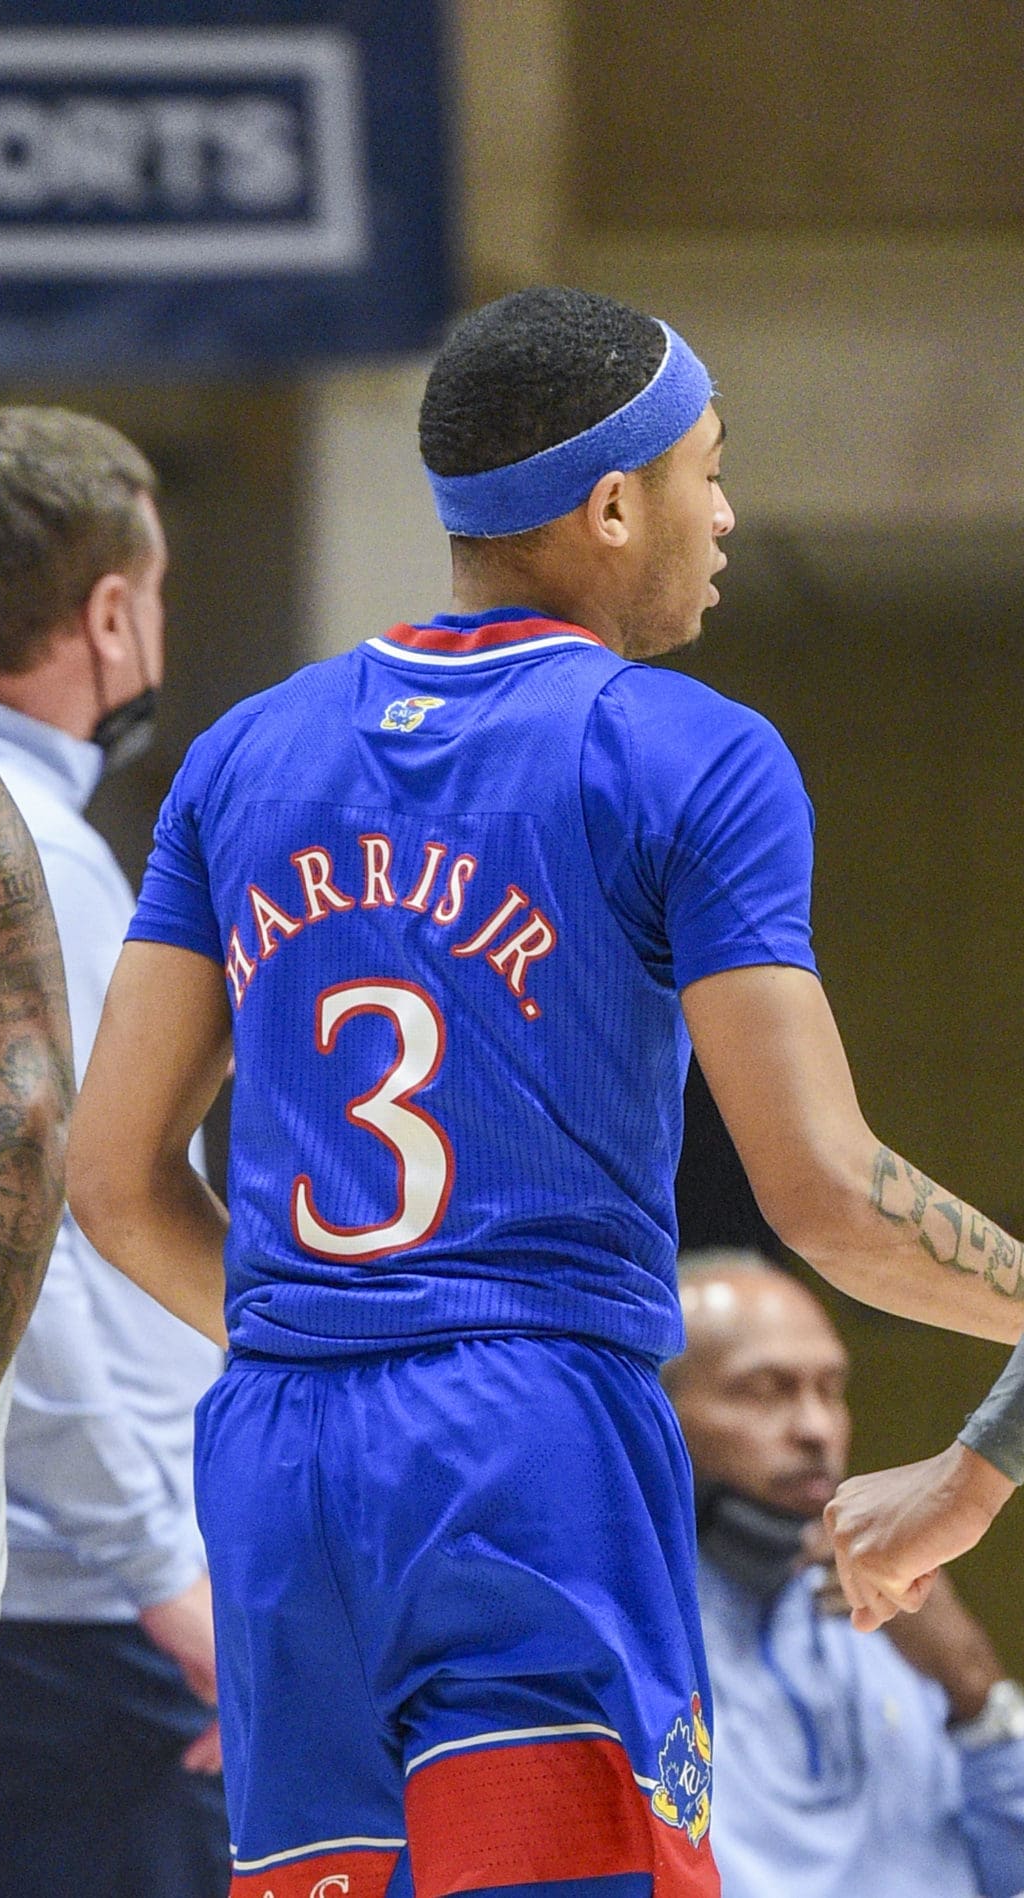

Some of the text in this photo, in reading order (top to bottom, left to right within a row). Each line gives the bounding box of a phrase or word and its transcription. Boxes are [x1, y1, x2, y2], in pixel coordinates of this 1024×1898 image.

[225, 833, 557, 1021] HARRIS JR.
[291, 976, 456, 1263] 3
[679, 1759, 701, 1797] KU
